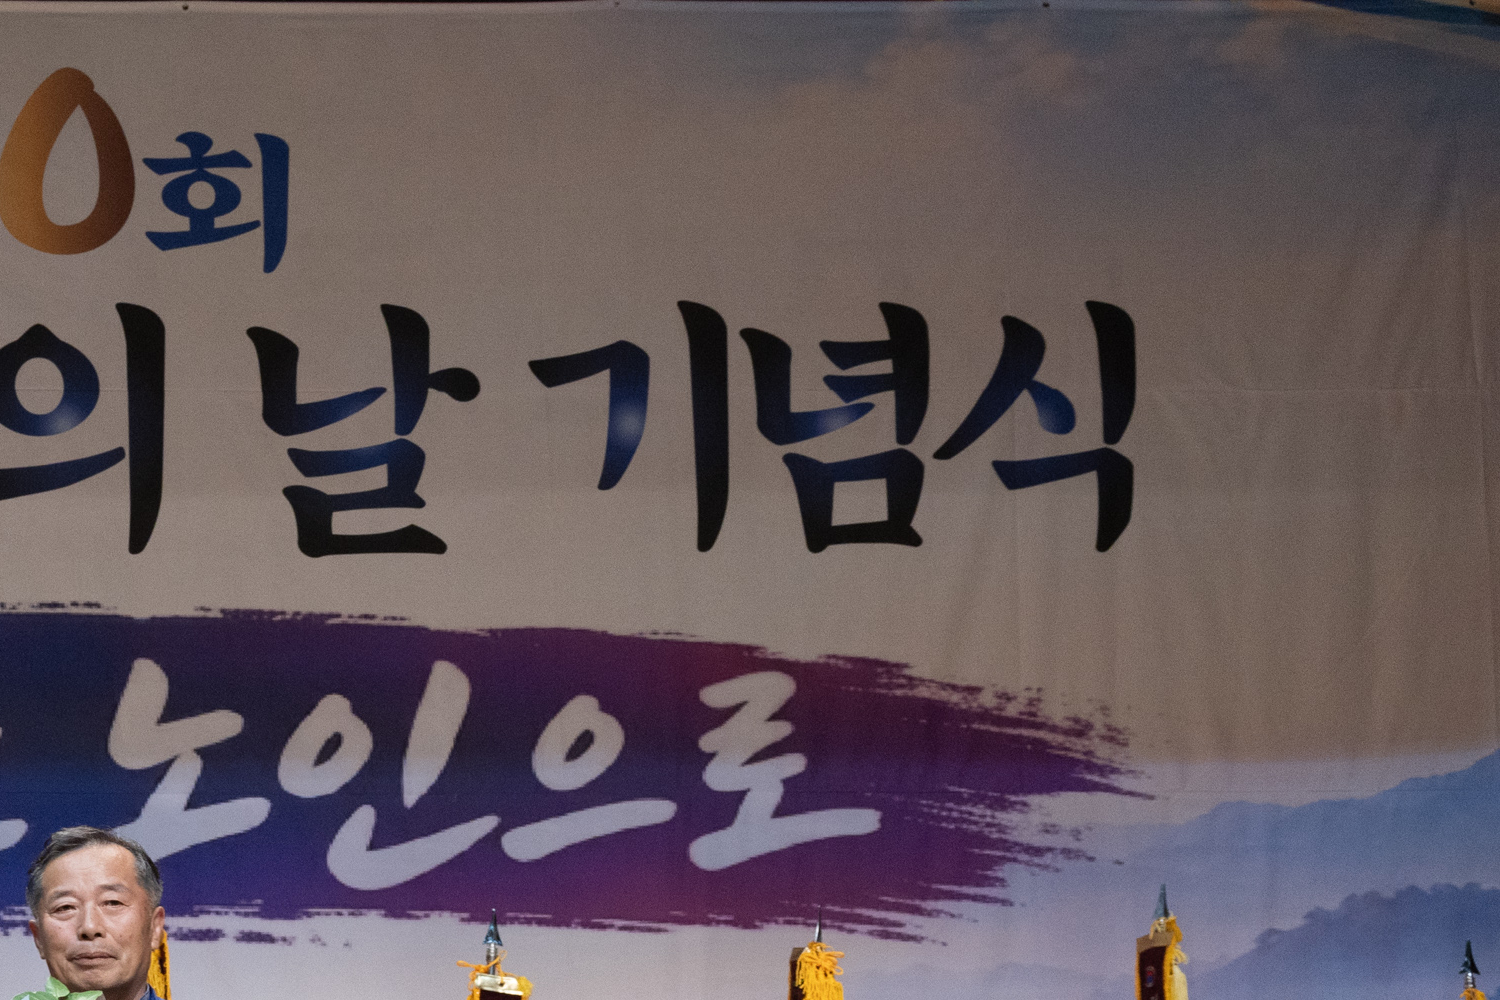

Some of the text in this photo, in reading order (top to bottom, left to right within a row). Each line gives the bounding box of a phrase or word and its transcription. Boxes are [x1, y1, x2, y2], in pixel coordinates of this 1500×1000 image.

[245, 302, 482, 559] 날
[527, 299, 1137, 554] 기념식
[107, 657, 883, 892] 노인으로
